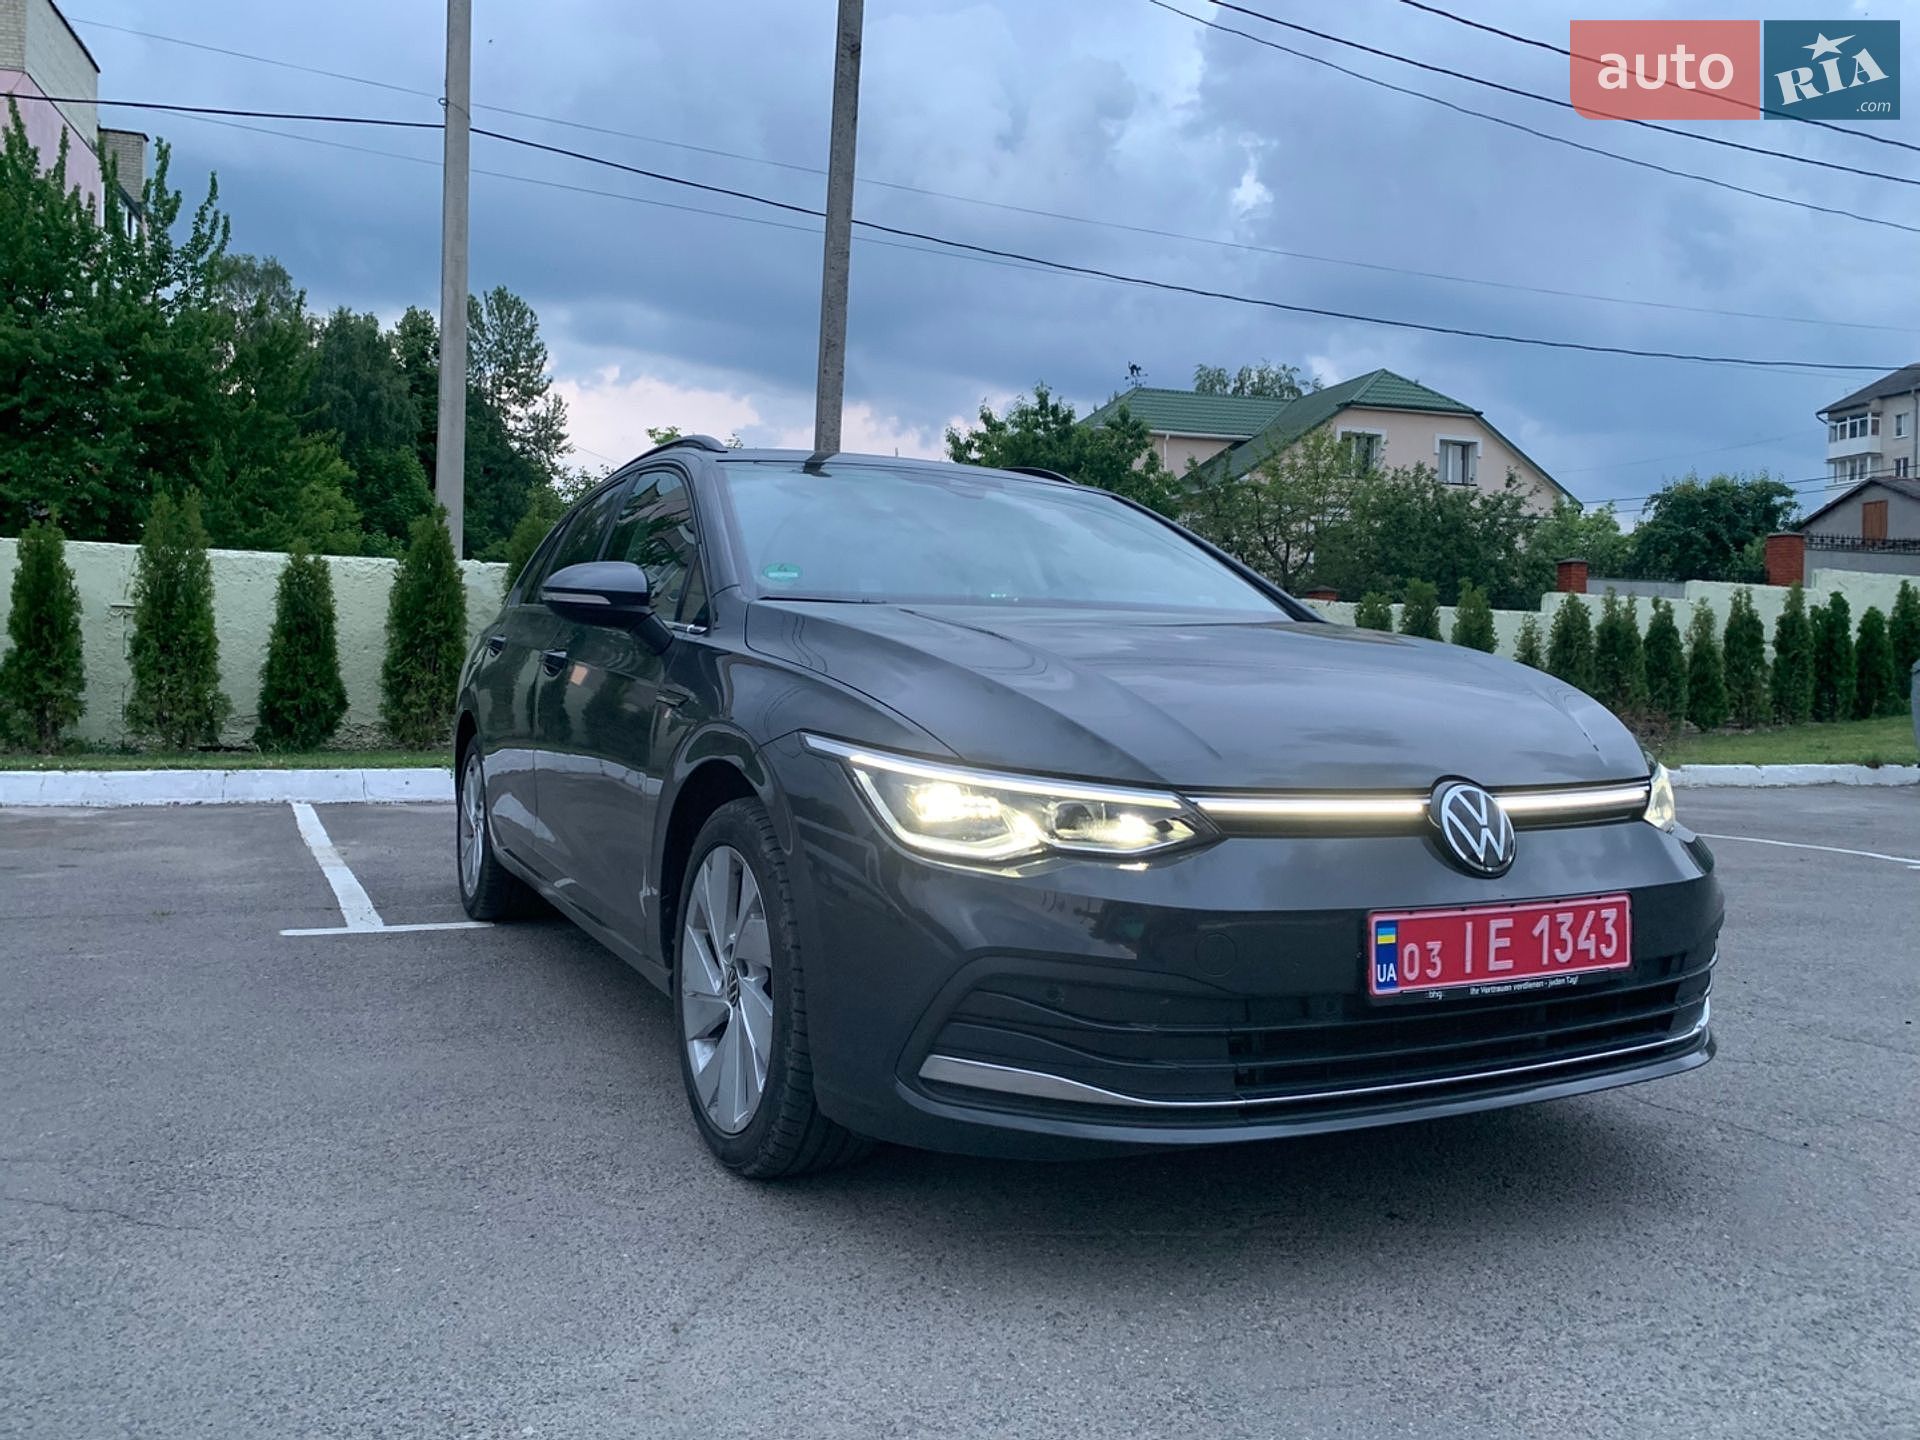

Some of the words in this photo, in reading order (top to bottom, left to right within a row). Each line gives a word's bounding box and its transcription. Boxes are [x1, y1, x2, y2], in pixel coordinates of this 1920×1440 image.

[1403, 941, 1443, 981] 03
[1465, 918, 1514, 974] IE
[1532, 908, 1618, 966] 1343
[1377, 963, 1397, 982] UA
